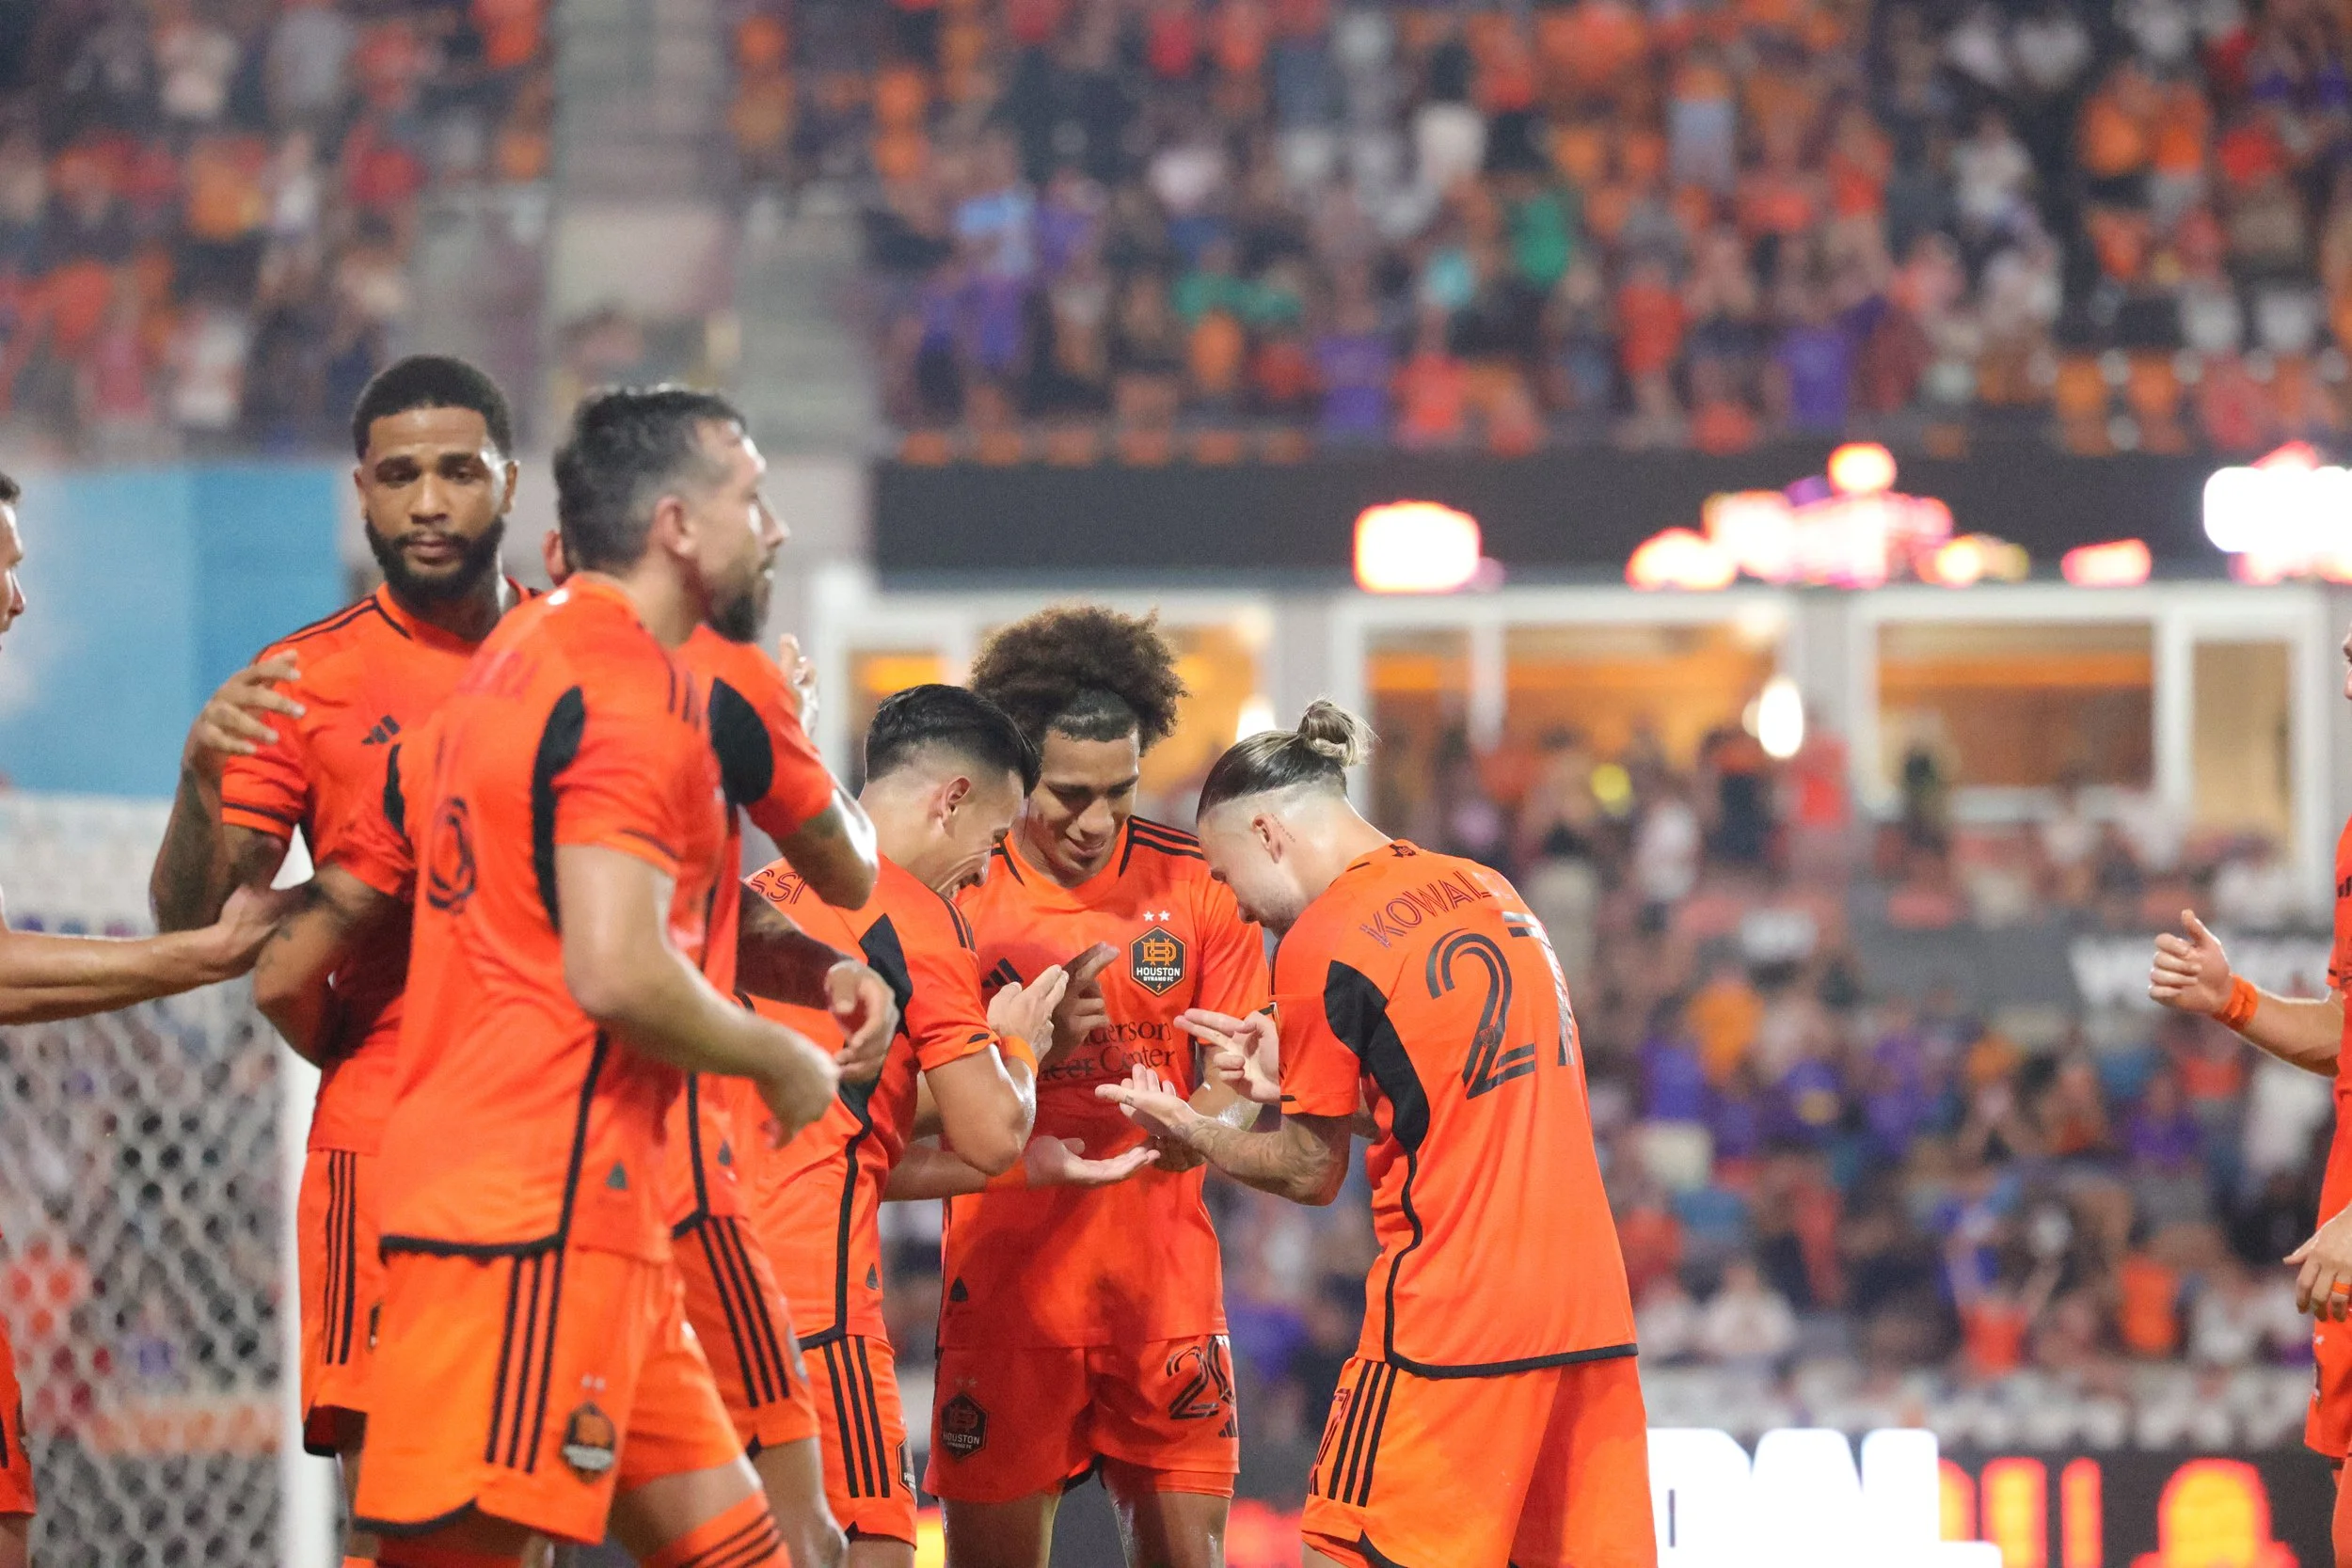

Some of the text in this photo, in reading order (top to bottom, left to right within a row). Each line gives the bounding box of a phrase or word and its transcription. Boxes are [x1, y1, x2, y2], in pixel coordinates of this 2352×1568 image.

[1359, 870, 1514, 949] KOWAL
[1136, 967, 1181, 976] HOUSTON
[1425, 911, 1576, 1101] 27
[1084, 1020, 1172, 1046] derson
